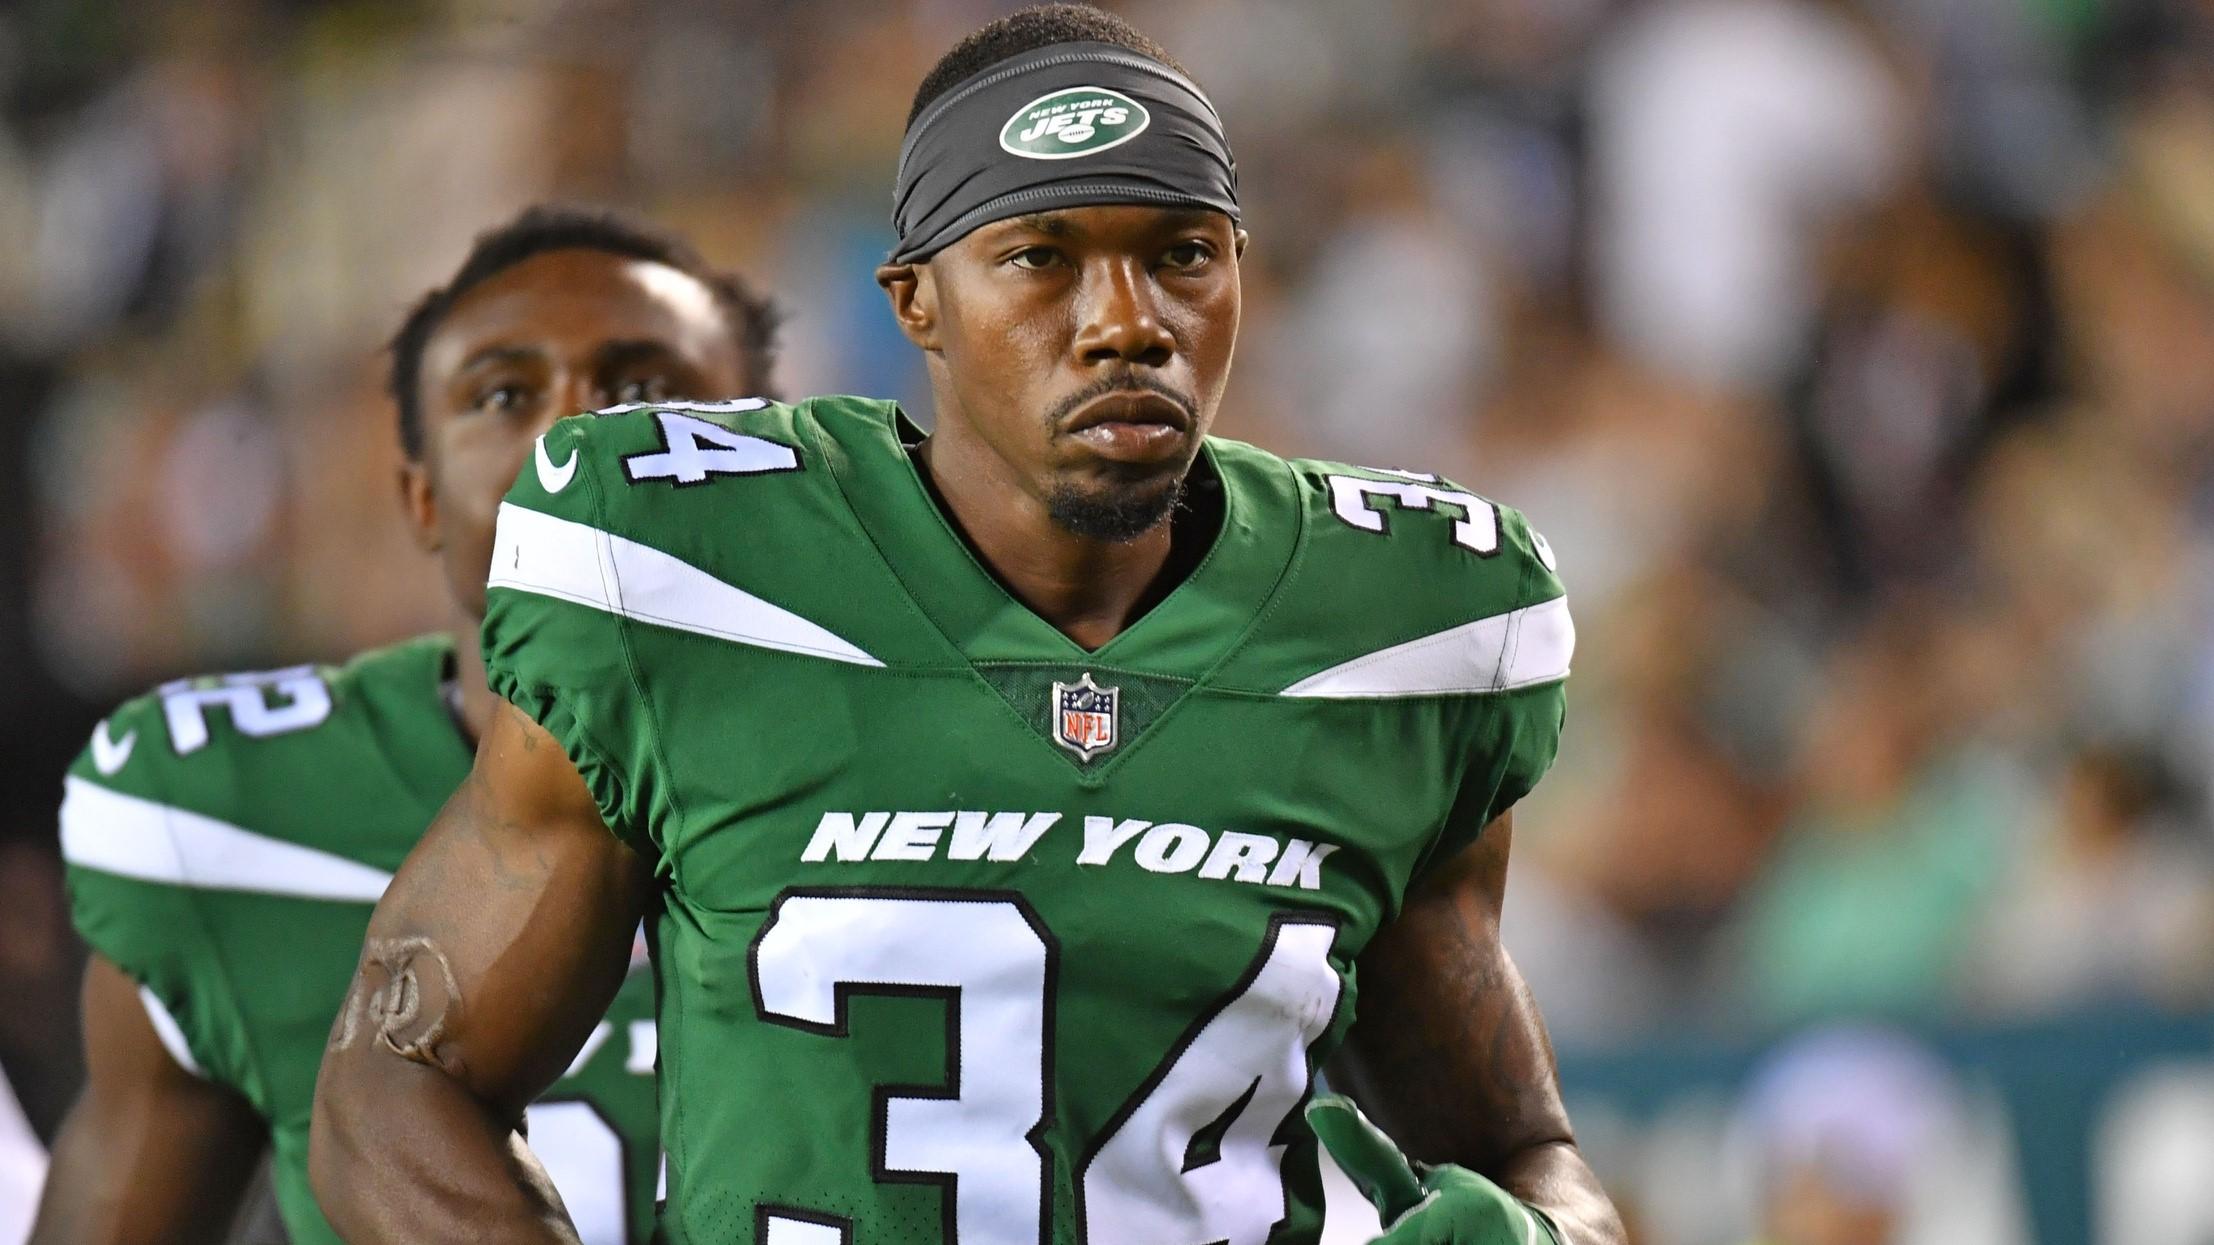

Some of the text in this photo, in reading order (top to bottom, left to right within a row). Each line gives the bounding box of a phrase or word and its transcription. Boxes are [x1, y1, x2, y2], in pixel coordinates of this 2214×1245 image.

[1020, 108, 1129, 142] JETS
[1029, 99, 1114, 120] NEW YORK
[588, 397, 804, 488] 4
[1065, 712, 1107, 743] NFL
[801, 811, 1340, 890] NEW YORK
[747, 886, 1343, 1245] 34
